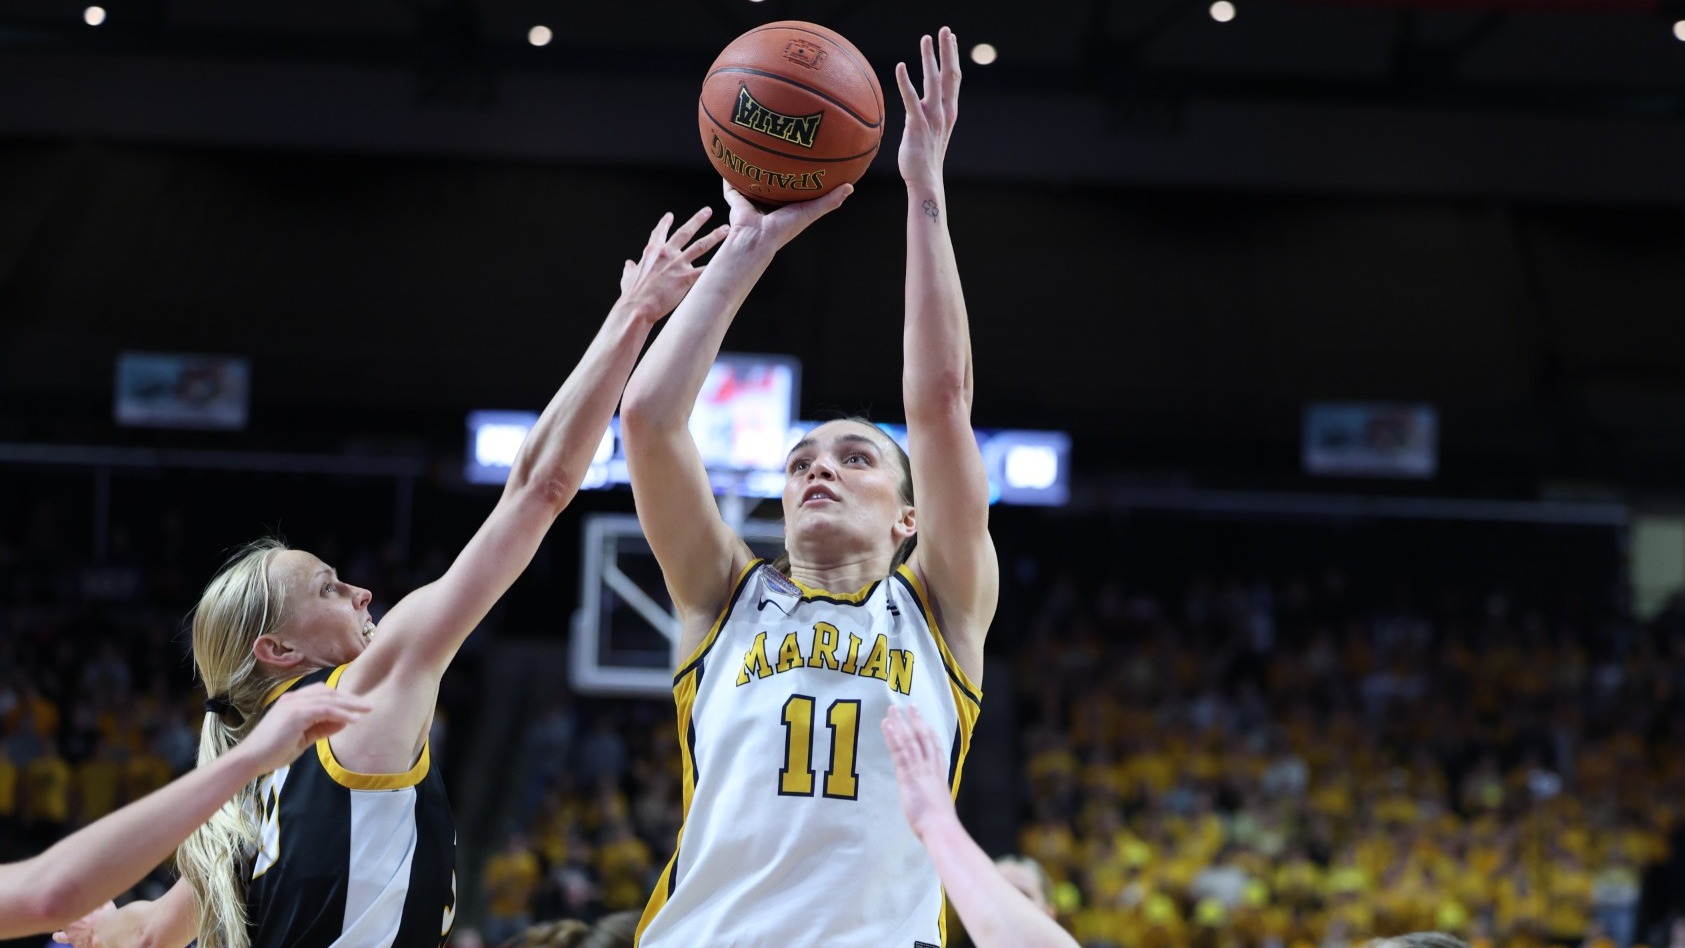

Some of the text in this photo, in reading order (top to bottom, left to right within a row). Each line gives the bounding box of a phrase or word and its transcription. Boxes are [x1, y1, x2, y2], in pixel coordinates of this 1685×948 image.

[735, 87, 823, 148] NAIA
[711, 133, 826, 191] SPALDING
[736, 621, 914, 696] MARIAN
[777, 694, 861, 801] 11
